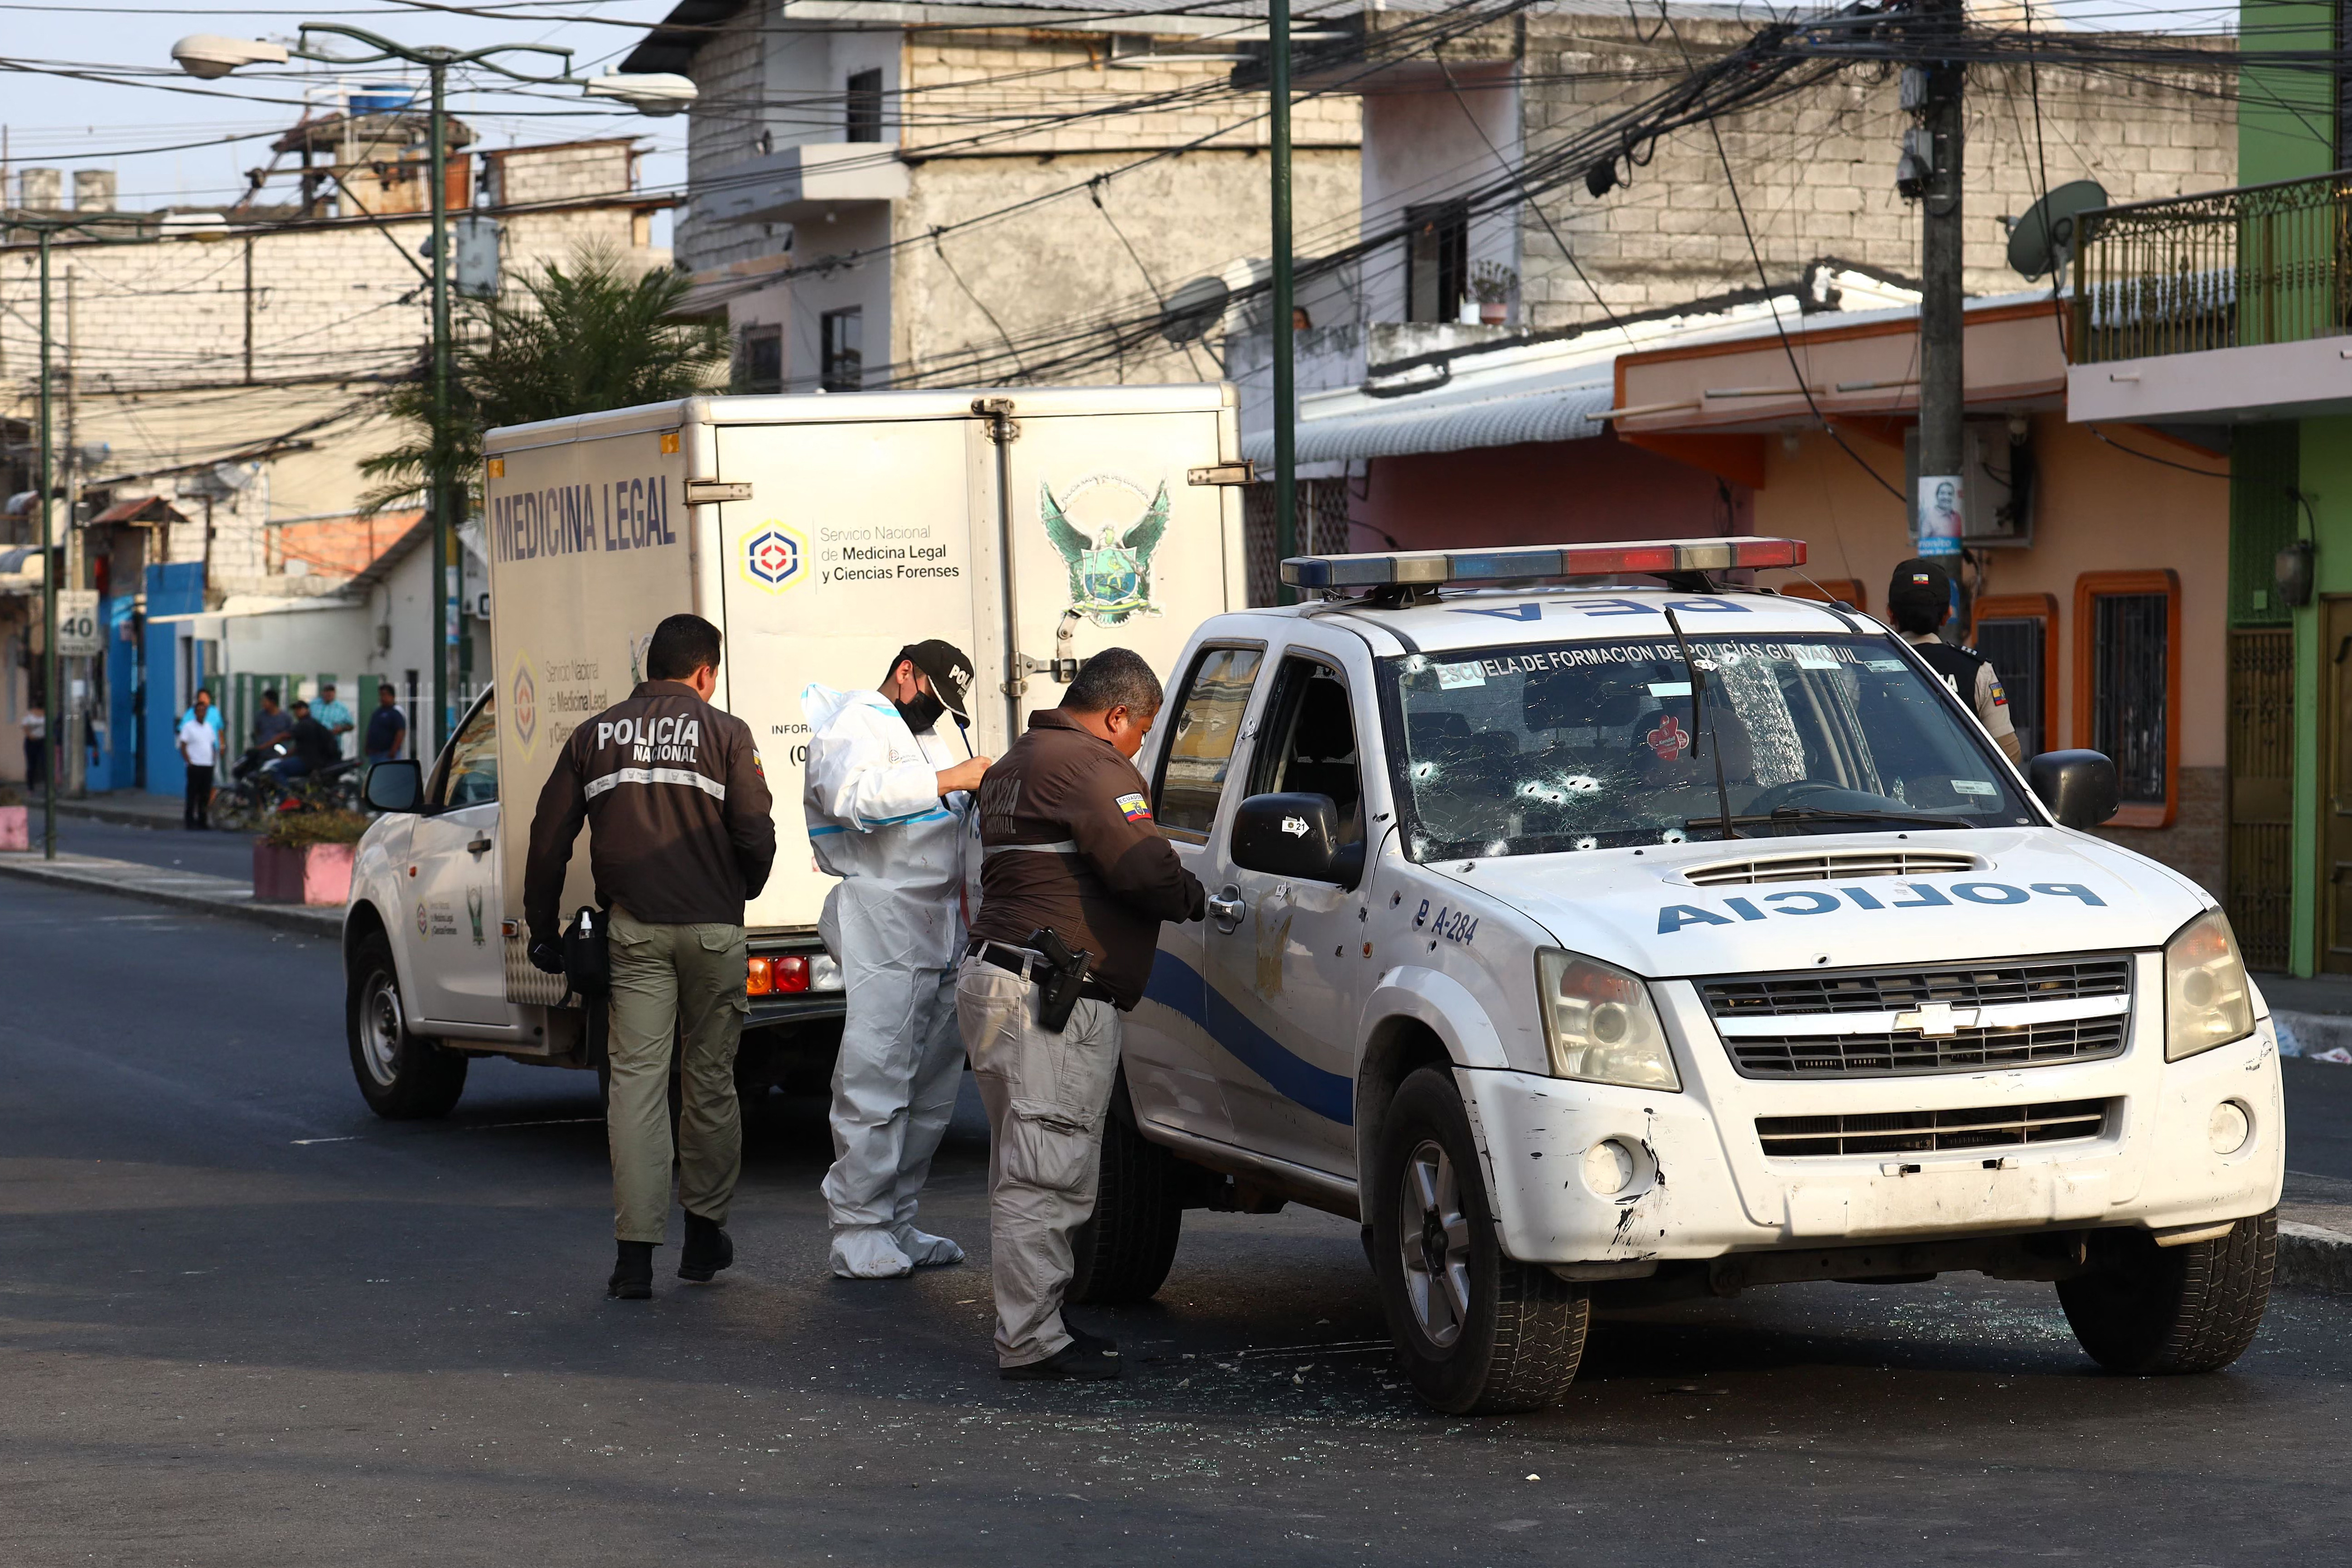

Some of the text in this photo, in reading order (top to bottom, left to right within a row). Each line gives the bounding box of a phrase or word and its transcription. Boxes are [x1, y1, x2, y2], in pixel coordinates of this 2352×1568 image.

[495, 475, 676, 562] MEDICINA LEGAL
[820, 525, 930, 541] Servicio Nacional
[821, 545, 946, 561] de Medicina Legal
[822, 565, 959, 584] y Ciencias Forenses
[60, 617, 92, 638] 40
[546, 658, 599, 682] Servicio Nacional
[1435, 657, 1522, 685] ESCUELA
[1522, 653, 1550, 672] DE
[1547, 645, 1657, 668] FORMACION
[1655, 644, 1682, 660] DE
[1765, 643, 1864, 664] GUAYAQUIL
[547, 689, 607, 713] de Medicina Legal
[598, 713, 699, 750] POLICÍA
[633, 745, 697, 763] NACIONAL
[1118, 795, 1142, 803] ECUADOR
[1431, 907, 1479, 945] A-284
